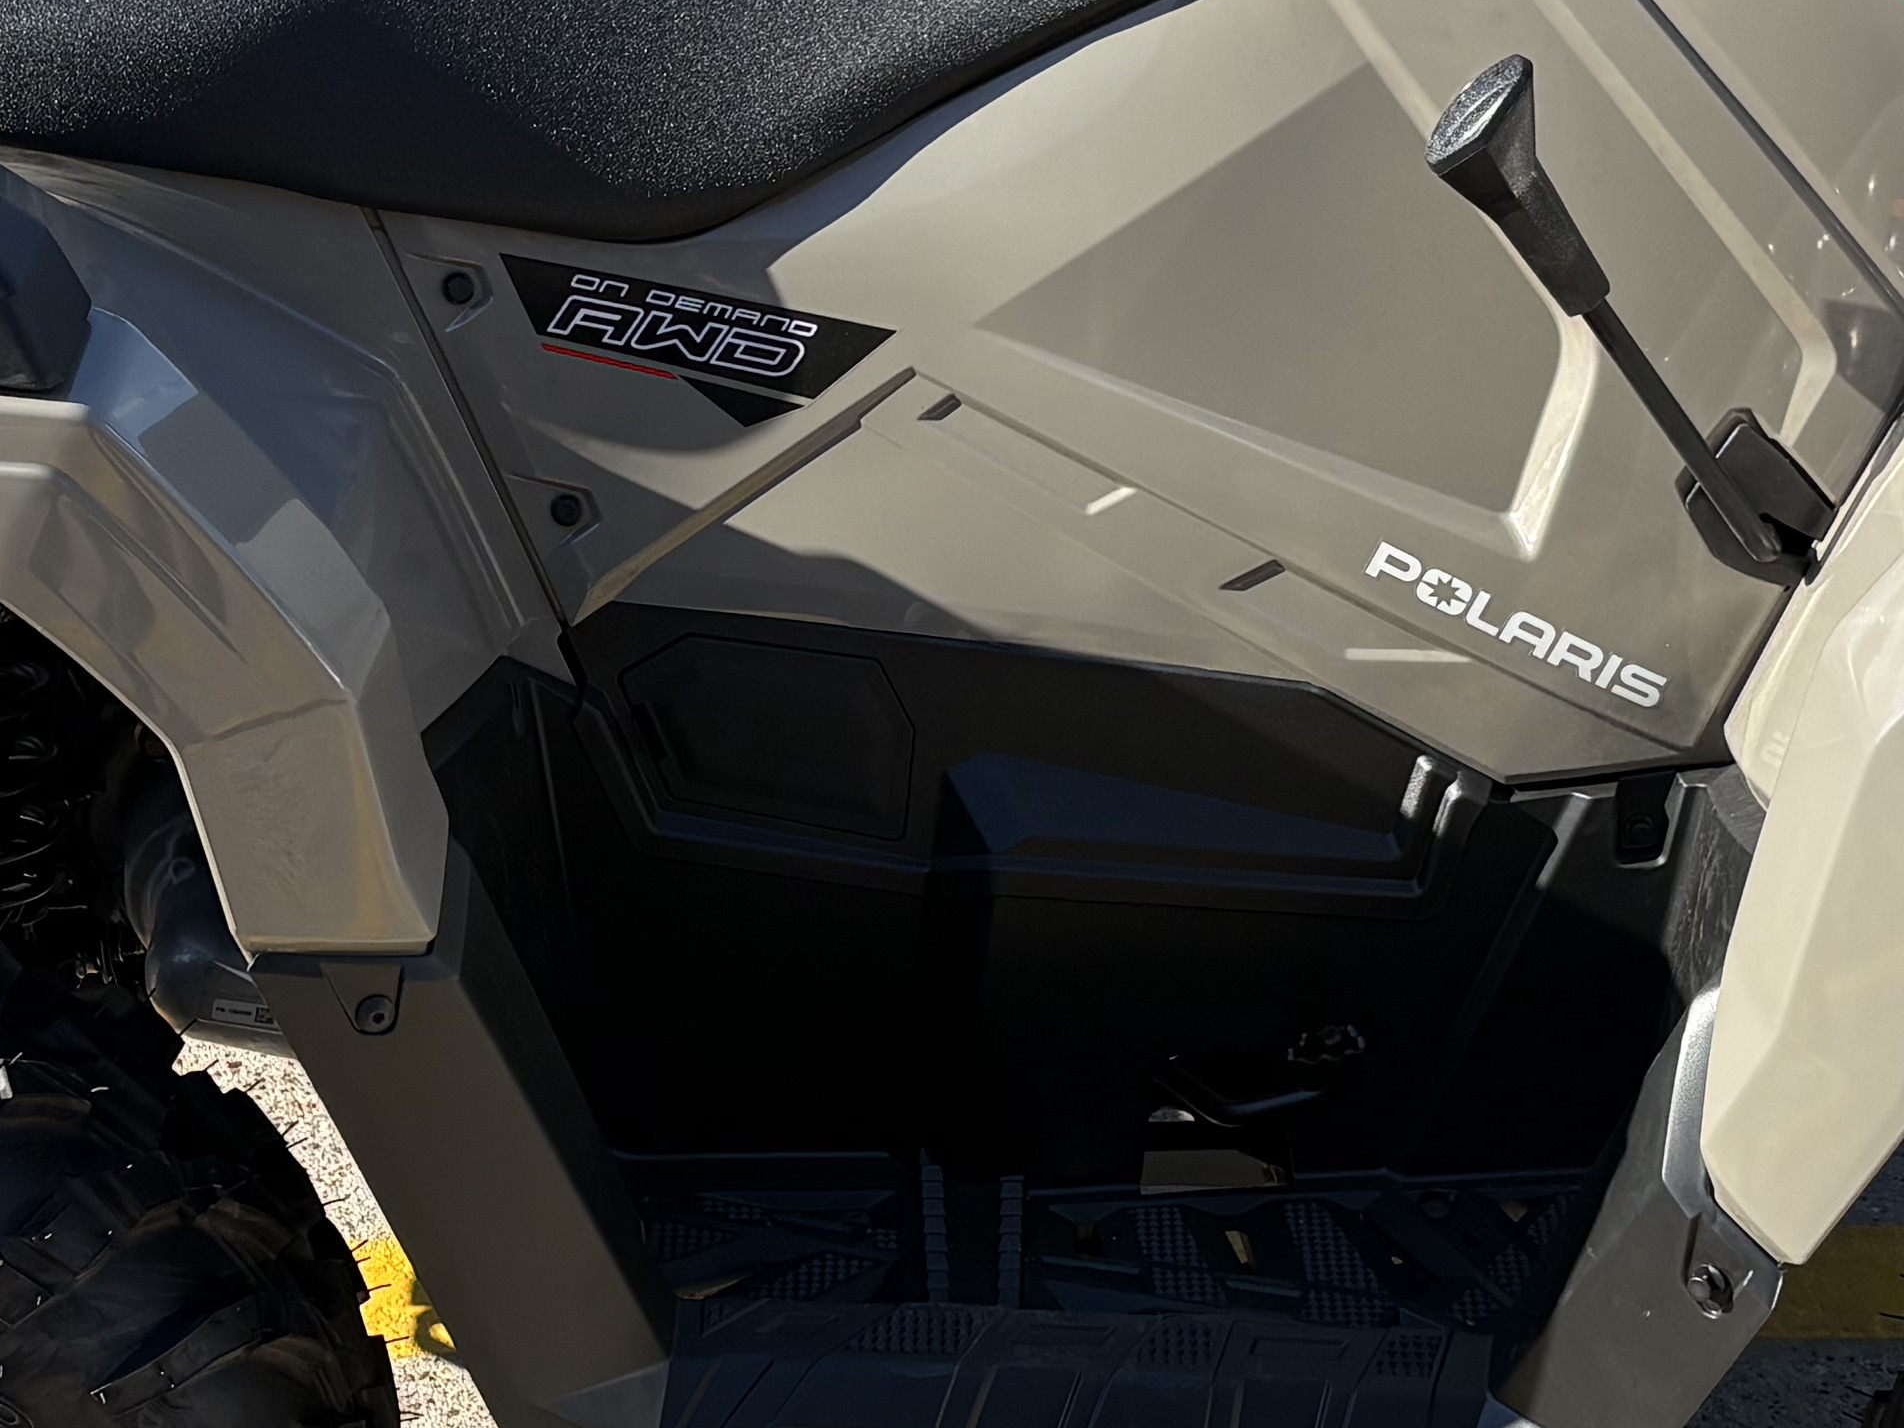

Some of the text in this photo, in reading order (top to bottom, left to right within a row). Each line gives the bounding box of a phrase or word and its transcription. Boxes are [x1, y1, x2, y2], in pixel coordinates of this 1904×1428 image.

[547, 295, 805, 377] AWD
[571, 274, 817, 337] ON DEMAND
[1365, 541, 1667, 707] POLARIS
